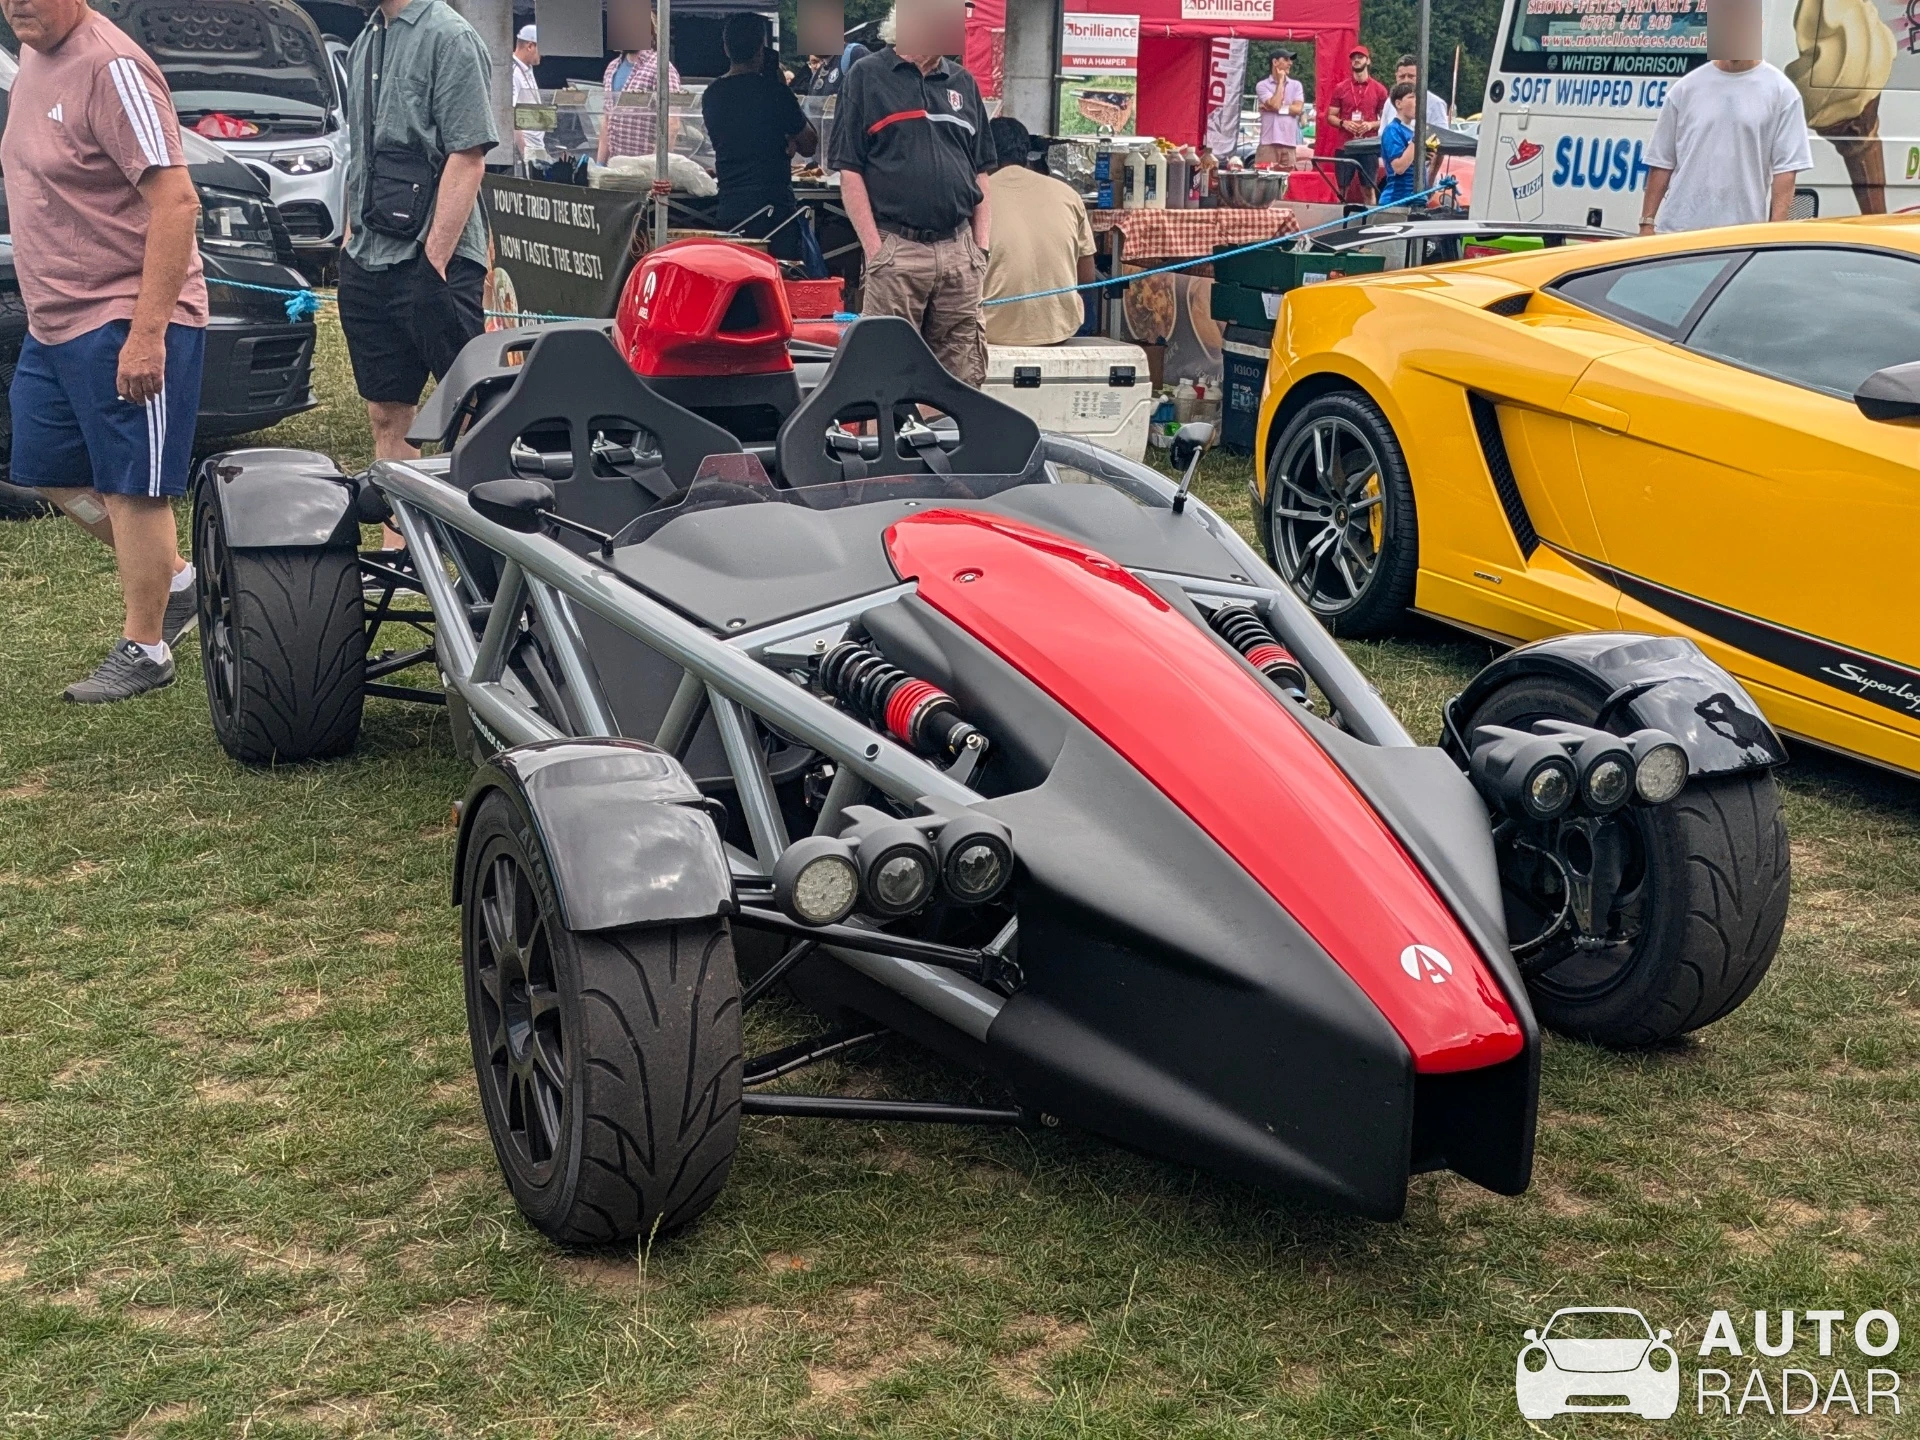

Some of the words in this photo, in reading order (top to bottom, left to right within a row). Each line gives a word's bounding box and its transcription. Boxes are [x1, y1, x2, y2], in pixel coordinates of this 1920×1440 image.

[1197, 0, 1271, 12] brilliance
[1075, 23, 1137, 38] brilliance
[1072, 57, 1087, 66] WIN
[1088, 57, 1094, 66] A
[1095, 58, 1127, 66] HAMPER
[1562, 55, 1613, 71] WHITBY
[1613, 56, 1688, 73] MORRISON
[1510, 77, 1551, 105] SOFT
[1555, 78, 1633, 108] WHIPPED
[1637, 80, 1668, 109] ICE
[1515, 176, 1542, 199] SLUSH
[493, 188, 524, 216] YOU'VE
[525, 194, 550, 221] TRIED
[552, 199, 570, 225] THE
[571, 202, 600, 235] REST,
[500, 234, 521, 260] NOW
[522, 239, 552, 268] TASTE
[552, 246, 573, 273] THE
[573, 251, 603, 281] BEST!
